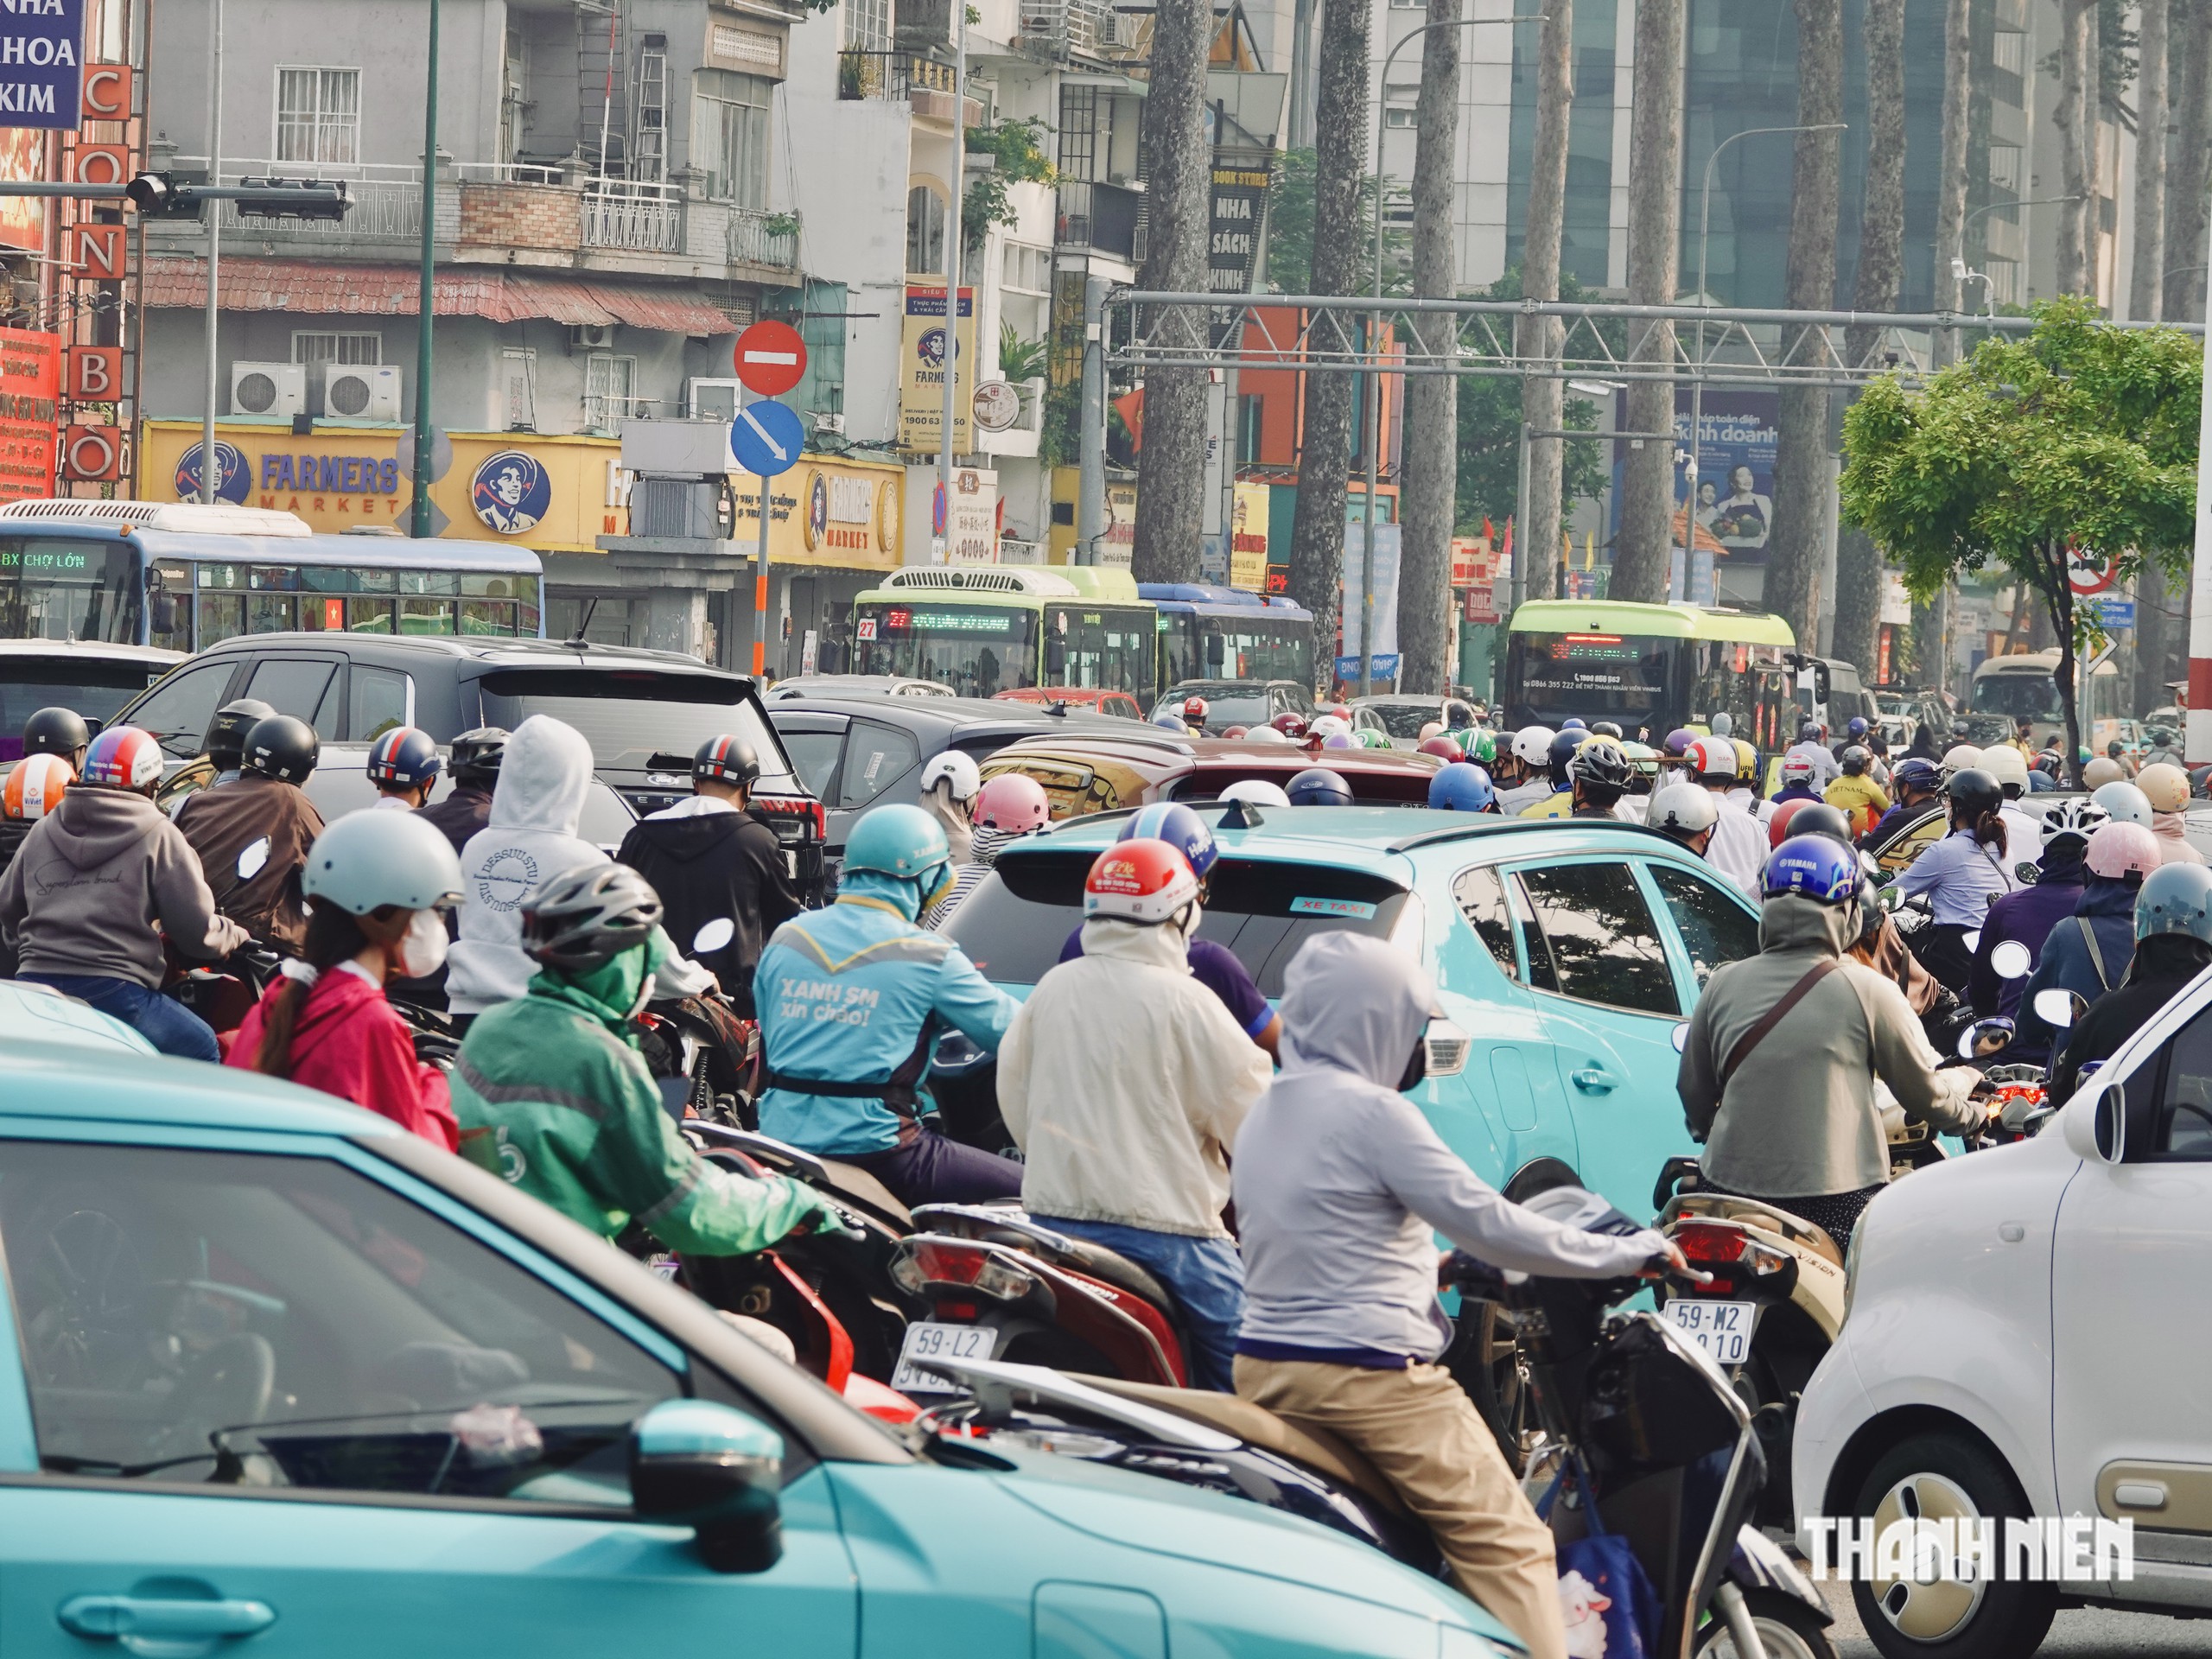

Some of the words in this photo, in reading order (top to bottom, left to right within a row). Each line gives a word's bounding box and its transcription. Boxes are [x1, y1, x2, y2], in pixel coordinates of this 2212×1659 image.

[0, 36, 76, 67] HOA
[0, 83, 55, 113] KIM
[1213, 170, 1236, 185] BOOK
[1238, 171, 1268, 187] STORE
[1211, 229, 1250, 254] SÁCH
[1210, 269, 1243, 290] KINH
[916, 371, 959, 384] FARMES
[905, 416, 927, 425] 1900
[1691, 412, 1715, 424] háp
[1716, 413, 1738, 423] toàn
[1738, 414, 1760, 426] điện
[1720, 423, 1778, 443] doanh
[261, 454, 399, 494] FARMERS
[260, 494, 399, 513] MARKET
[827, 529, 869, 550] MARKET
[2, 553, 19, 566] BX
[23, 554, 54, 570] CHỢ
[56, 552, 85, 568] LỚN
[859, 622, 874, 638] 27
[1548, 680, 1560, 689] 355
[1830, 785, 1863, 794] VIETNAM
[1787, 858, 1817, 871] YAMAHA
[1302, 900, 1324, 910] XE
[1329, 902, 1366, 914] TAXI
[780, 978, 841, 1002] XANH
[843, 985, 880, 1008] SM
[780, 1001, 807, 1019] xin
[1797, 1250, 1836, 1277] VISION
[1677, 1305, 1739, 1332] 59-M2
[916, 1329, 981, 1357] 59-L2
